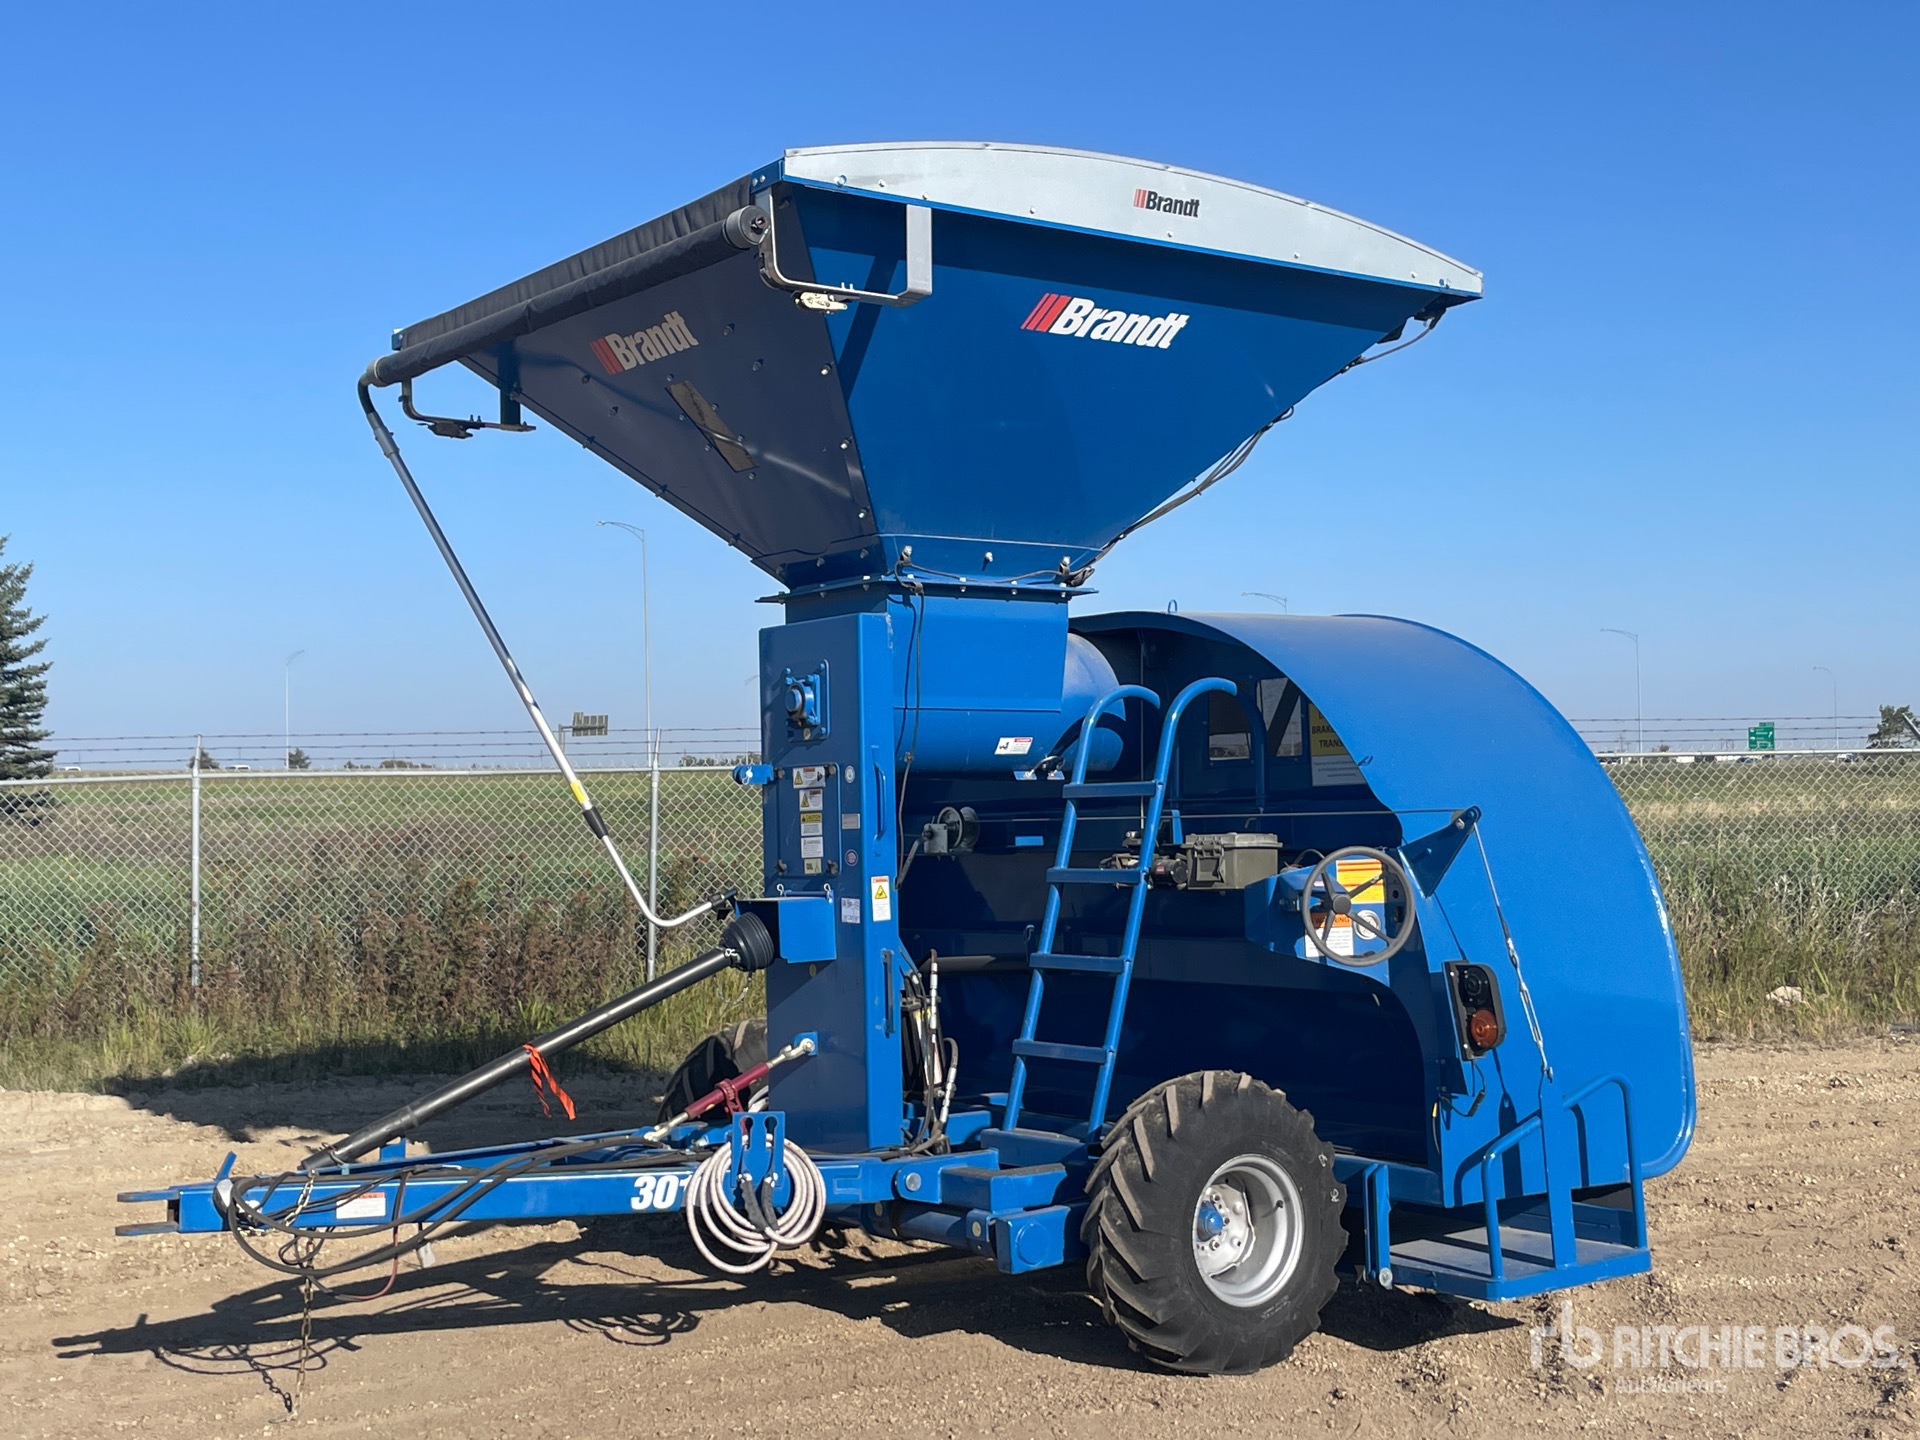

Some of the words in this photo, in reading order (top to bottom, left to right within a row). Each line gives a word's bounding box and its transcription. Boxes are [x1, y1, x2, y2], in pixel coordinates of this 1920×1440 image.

[1145, 190, 1200, 218] Brandt
[604, 310, 699, 371] Brandt
[1048, 297, 1190, 349] Brandt
